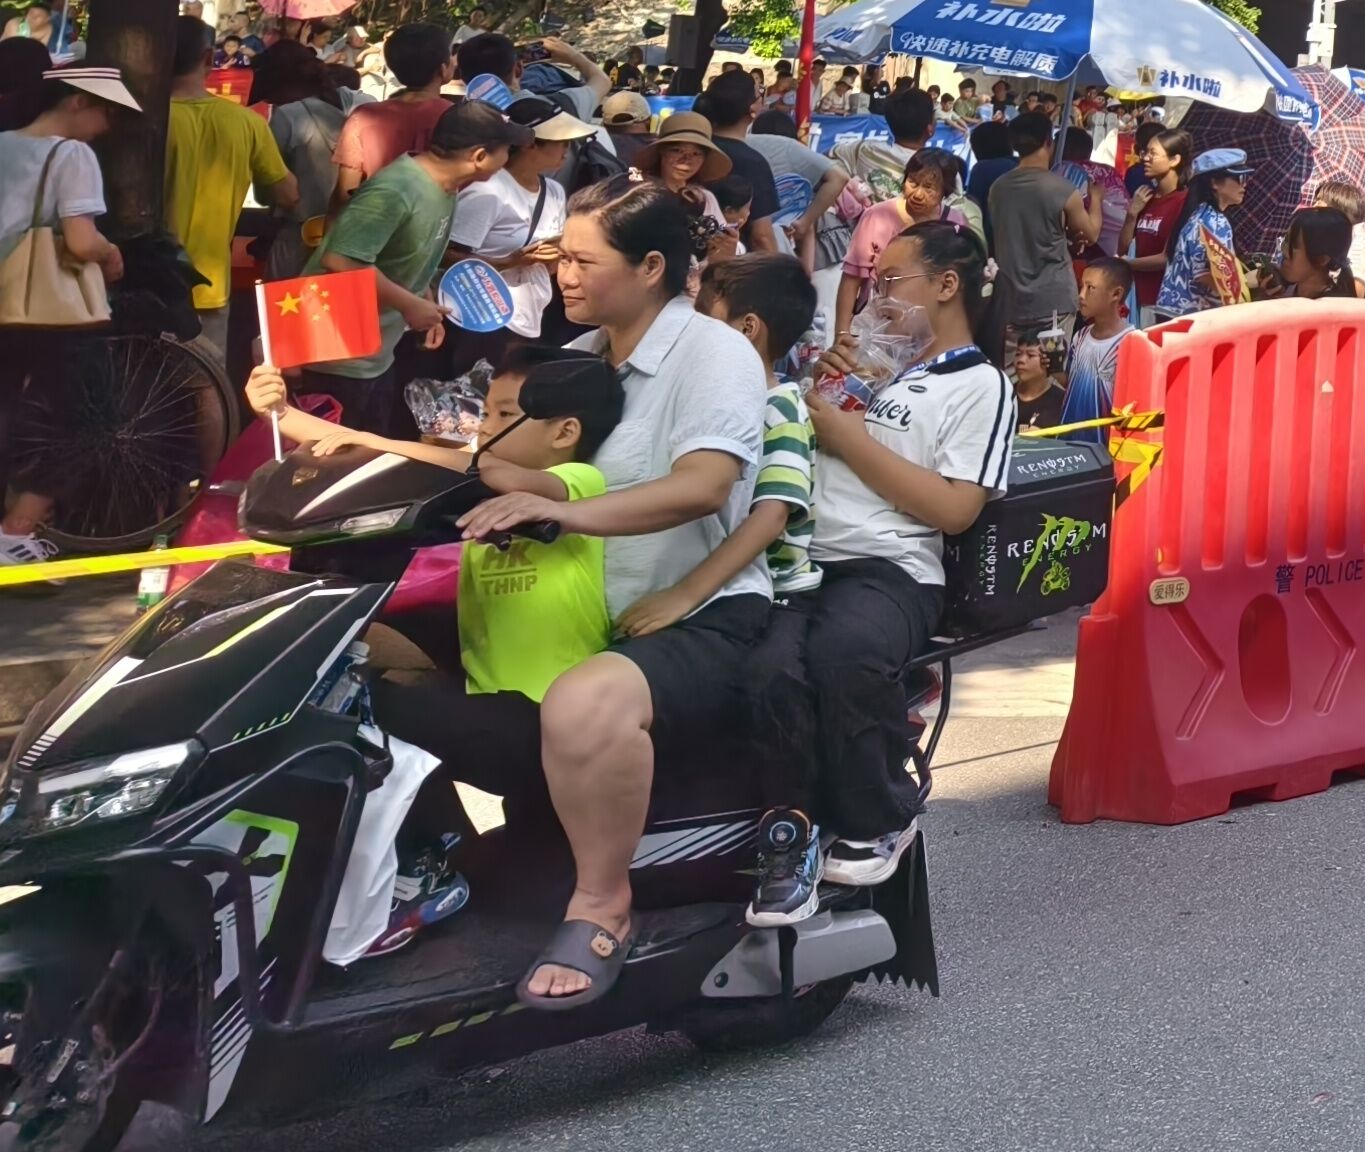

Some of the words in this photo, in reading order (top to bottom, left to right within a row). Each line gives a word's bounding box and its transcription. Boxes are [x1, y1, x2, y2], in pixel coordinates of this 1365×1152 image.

[935, 0, 1066, 34] 补水啦
[900, 31, 1059, 74] 快速补充电解质
[1160, 69, 1222, 98] 补水啦
[481, 575, 537, 596] THNP
[1153, 582, 1185, 600] 爱得乐
[1275, 563, 1294, 594] 警
[1305, 558, 1365, 587] POLICE
